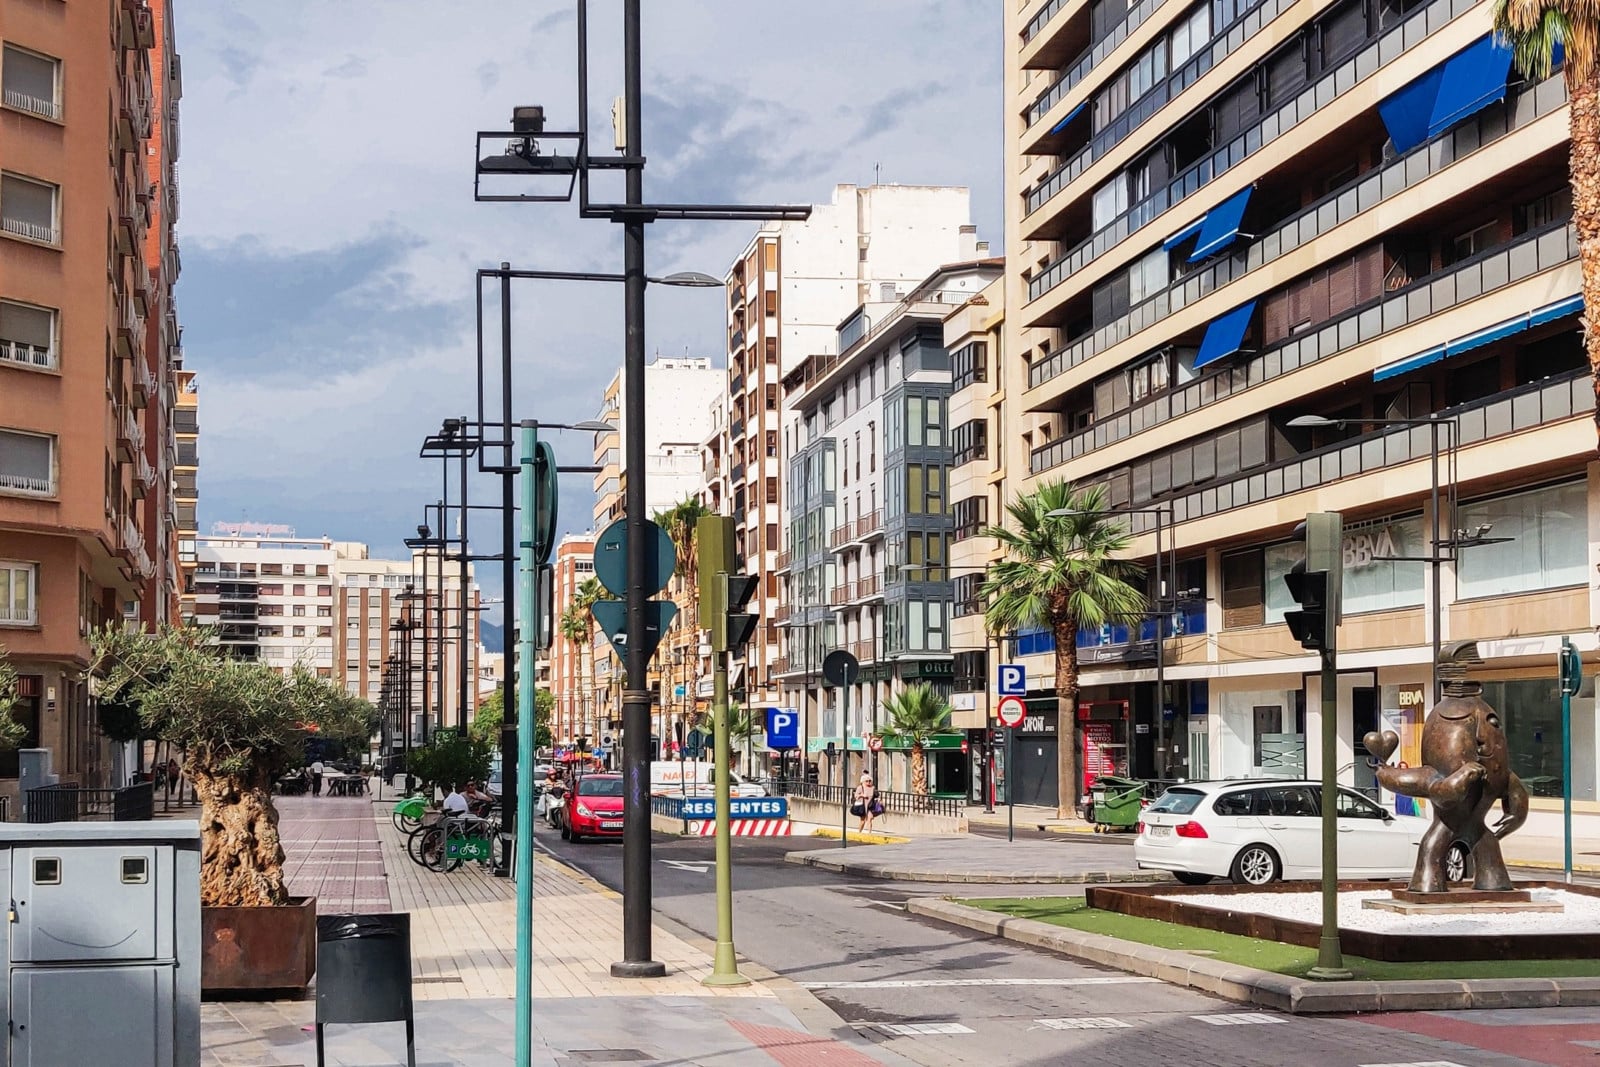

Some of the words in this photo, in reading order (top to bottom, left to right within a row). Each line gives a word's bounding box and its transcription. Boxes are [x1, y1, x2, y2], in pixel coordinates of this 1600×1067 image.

[1343, 527, 1396, 568] BBVA
[1003, 668, 1020, 692] P
[1399, 690, 1424, 706] BBVA
[774, 714, 791, 734] P
[684, 802, 781, 814] RESENTES
